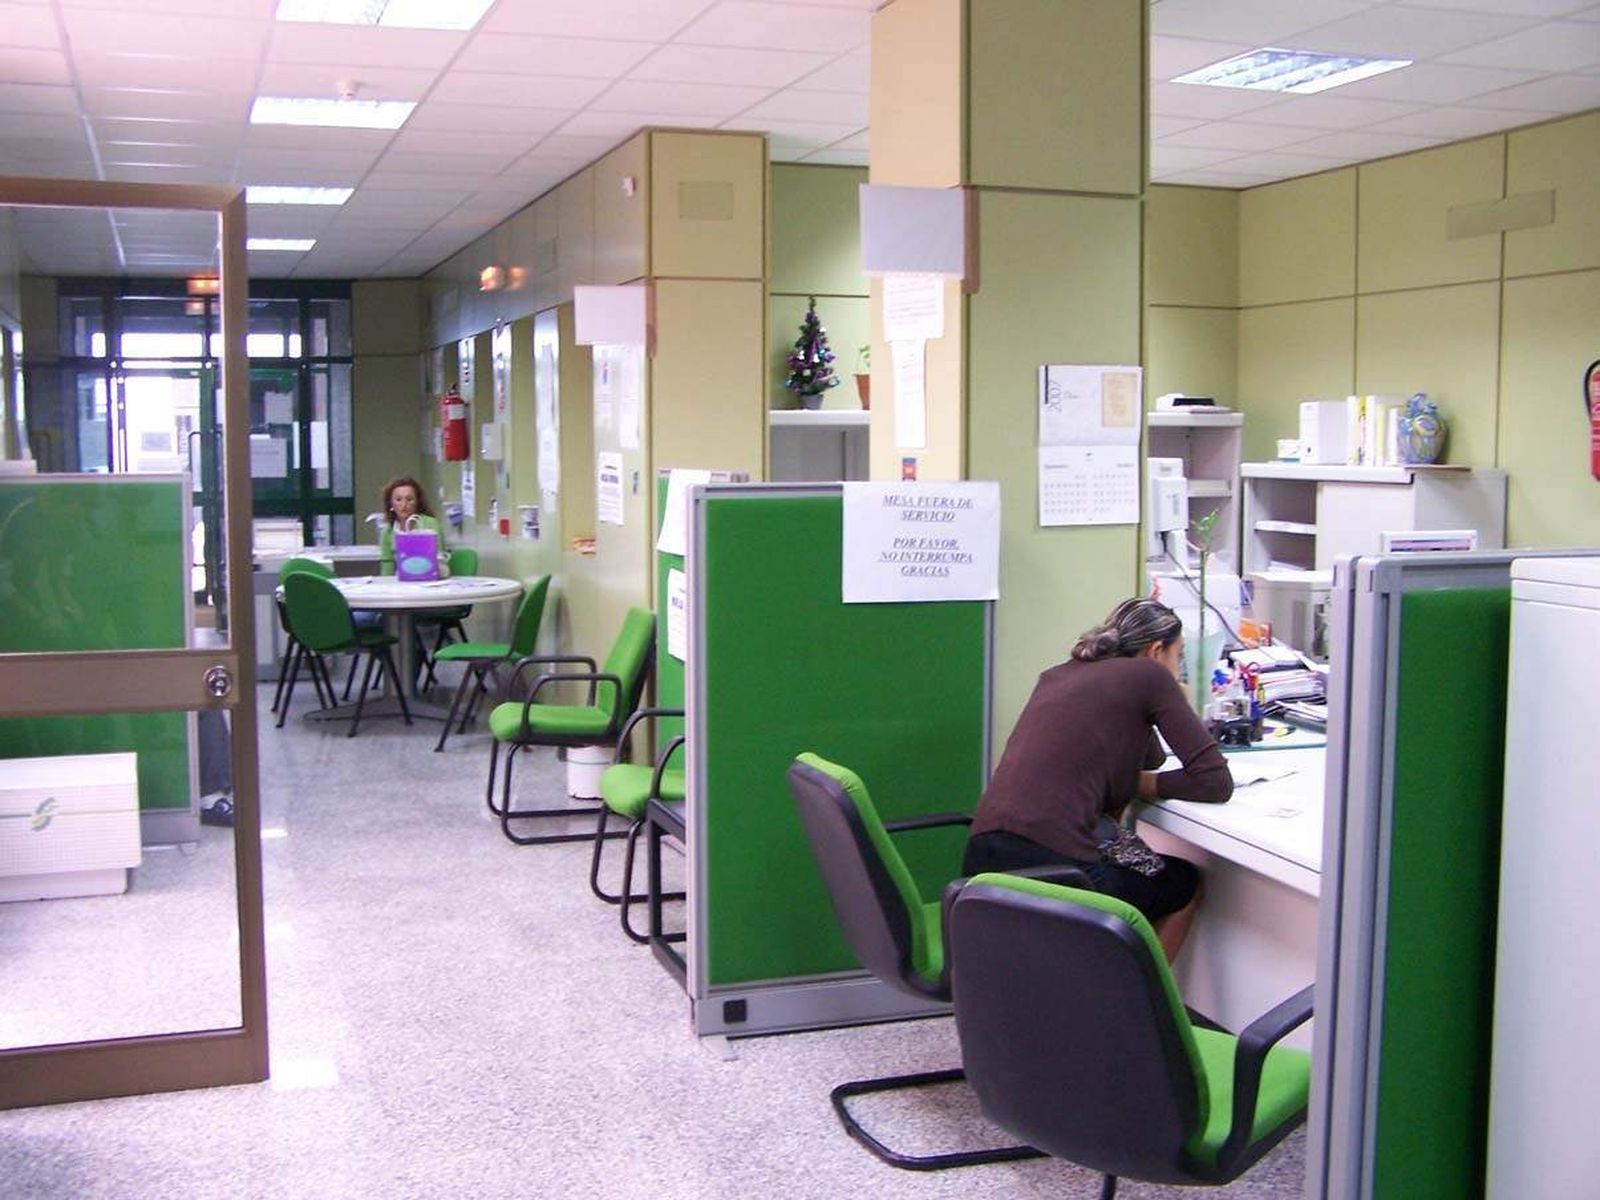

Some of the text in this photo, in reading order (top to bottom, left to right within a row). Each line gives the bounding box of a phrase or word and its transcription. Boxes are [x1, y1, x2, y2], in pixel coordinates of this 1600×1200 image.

[882, 495, 974, 510] MESA FUERA DE
[901, 511, 957, 522] SERVICIO
[892, 537, 917, 549] POR
[879, 552, 973, 564] NO INTERRUMPA
[900, 566, 950, 577] GRACIAS
